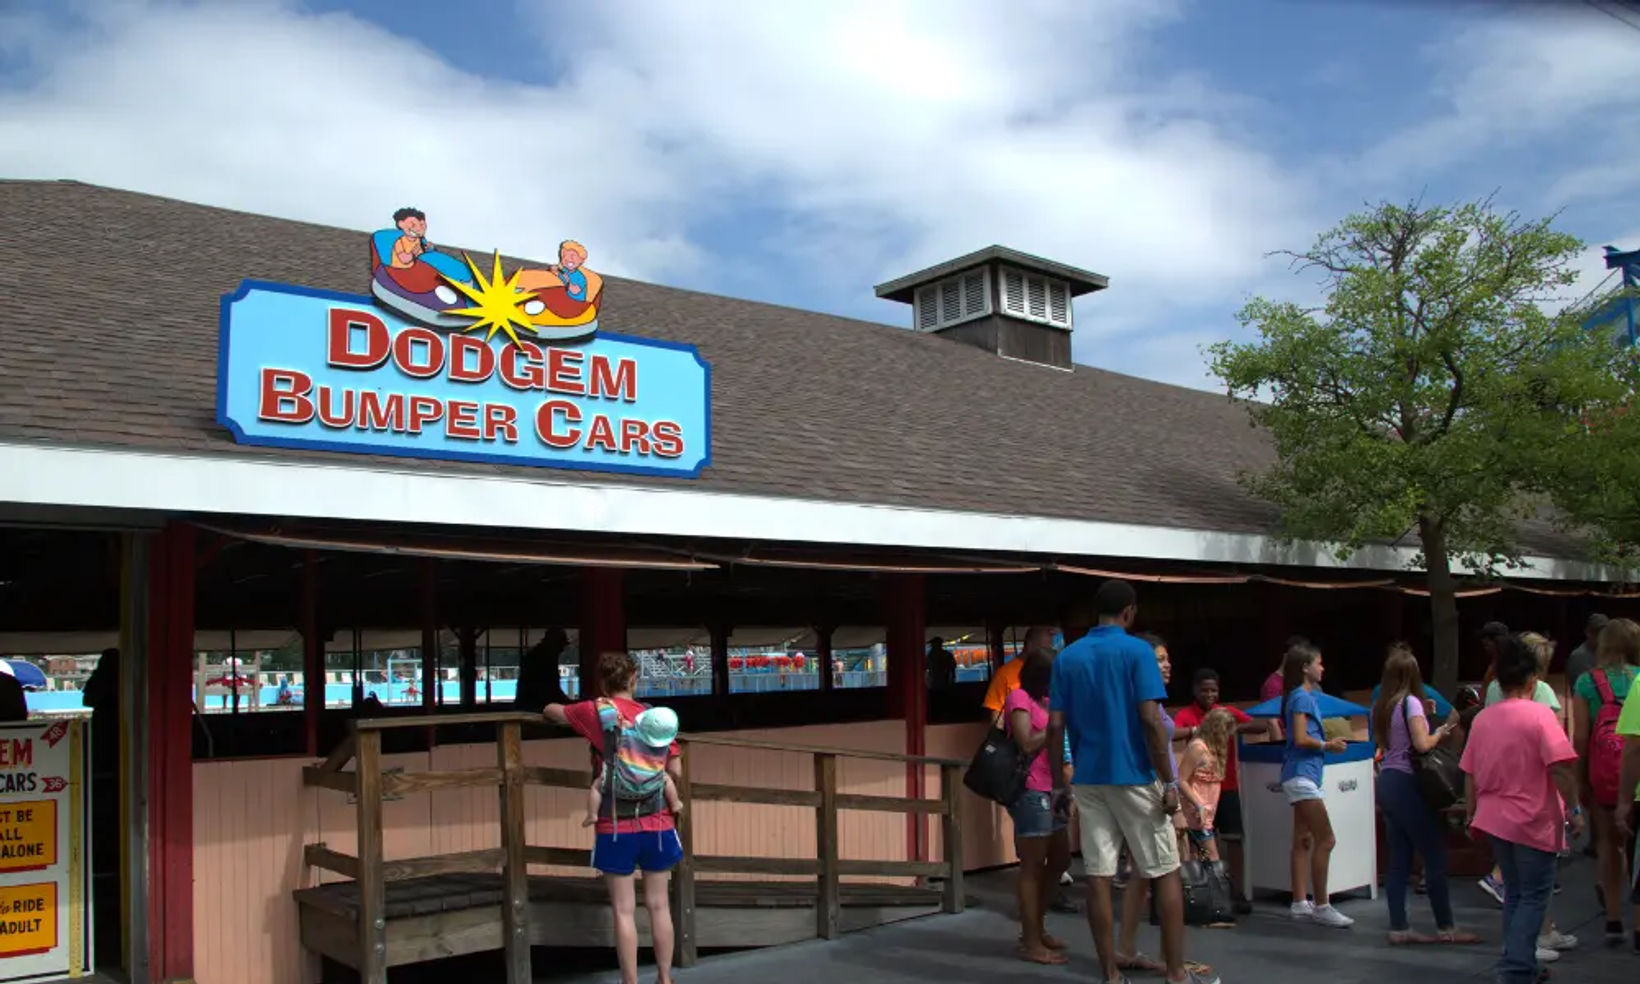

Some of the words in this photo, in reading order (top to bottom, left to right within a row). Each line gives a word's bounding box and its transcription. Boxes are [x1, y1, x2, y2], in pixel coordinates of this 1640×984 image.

[326, 306, 638, 401] DODGEM
[258, 366, 519, 442] BUMPER
[535, 399, 684, 457] CARS
[0, 772, 37, 793] CARS
[16, 809, 33, 822] BE
[1, 843, 45, 858] ALONE
[13, 898, 45, 912] RIDE
[0, 918, 42, 935] ADULT
